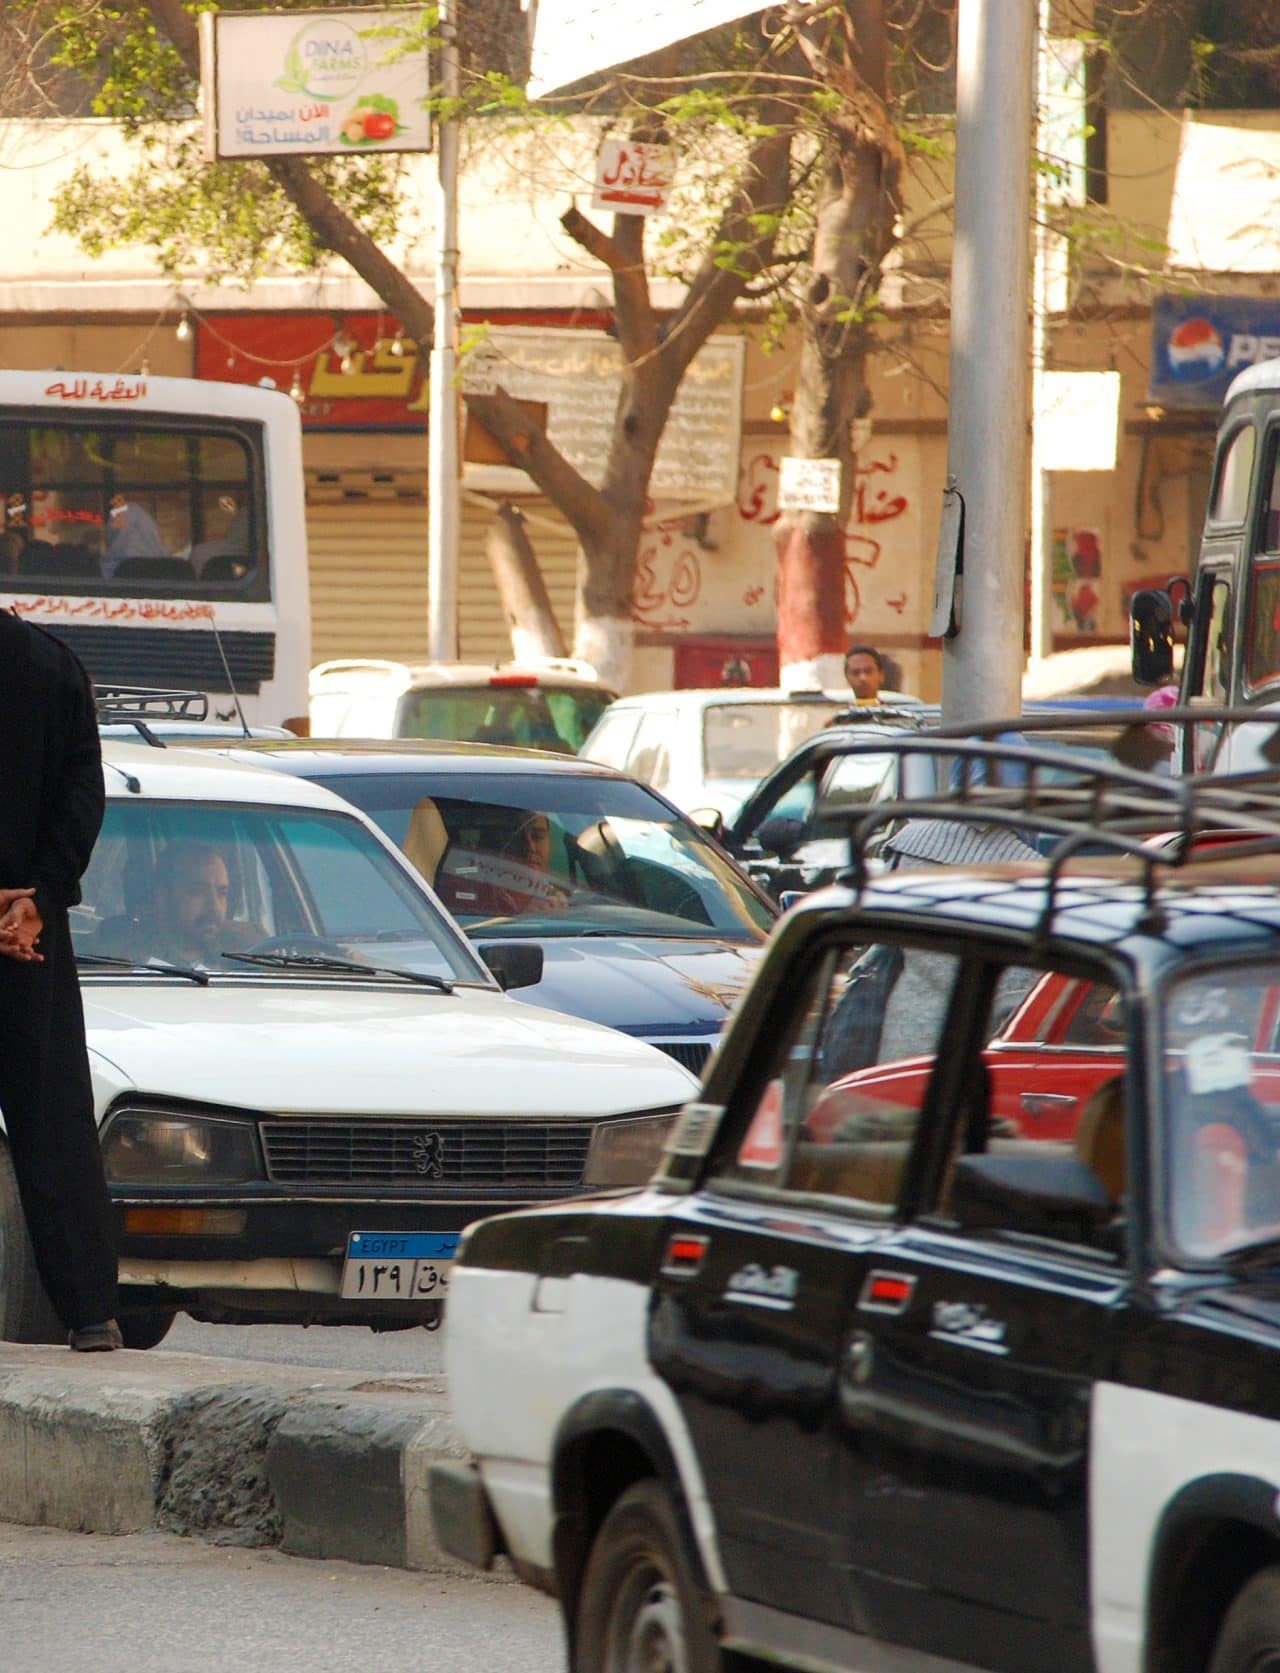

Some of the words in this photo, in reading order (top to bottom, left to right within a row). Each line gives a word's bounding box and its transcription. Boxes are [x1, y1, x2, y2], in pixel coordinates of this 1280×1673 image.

[305, 40, 353, 57] DINA
[45, 379, 87, 401] لله
[361, 1239, 409, 1253] EGYPT
